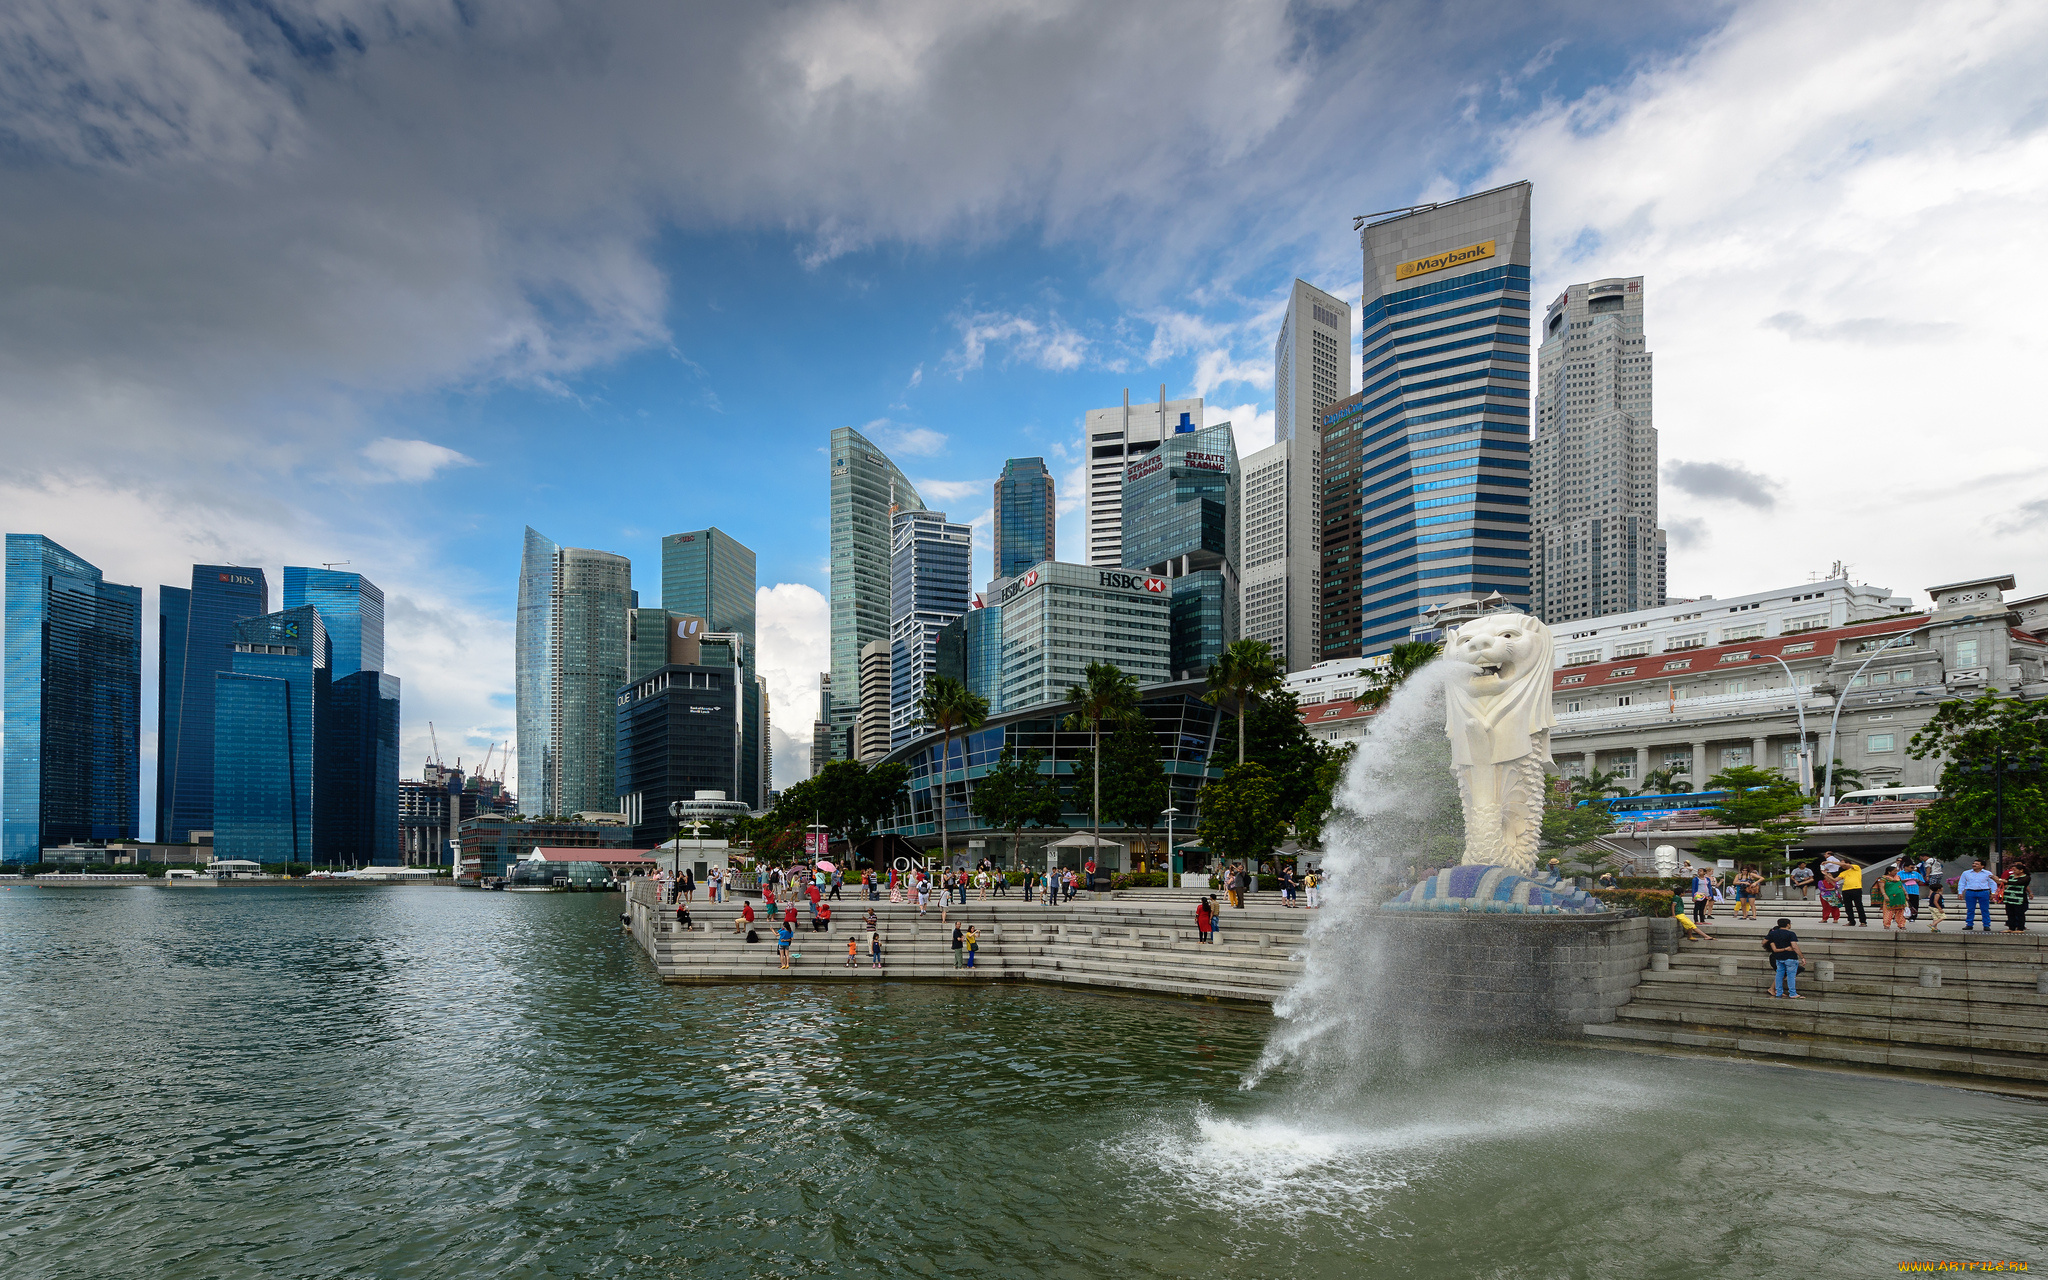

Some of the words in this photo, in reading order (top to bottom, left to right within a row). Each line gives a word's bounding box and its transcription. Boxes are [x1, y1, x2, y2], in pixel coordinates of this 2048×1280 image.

[1416, 245, 1486, 272] Maybank
[1127, 454, 1162, 475] STRAITS
[1184, 459, 1225, 472] TRADING
[1186, 451, 1225, 463] STRAITS
[1127, 462, 1163, 483] TRADING
[230, 574, 255, 585] DBS
[1099, 571, 1143, 591] HSBC
[1001, 577, 1026, 603] HSBC
[893, 856, 937, 872] ONE
